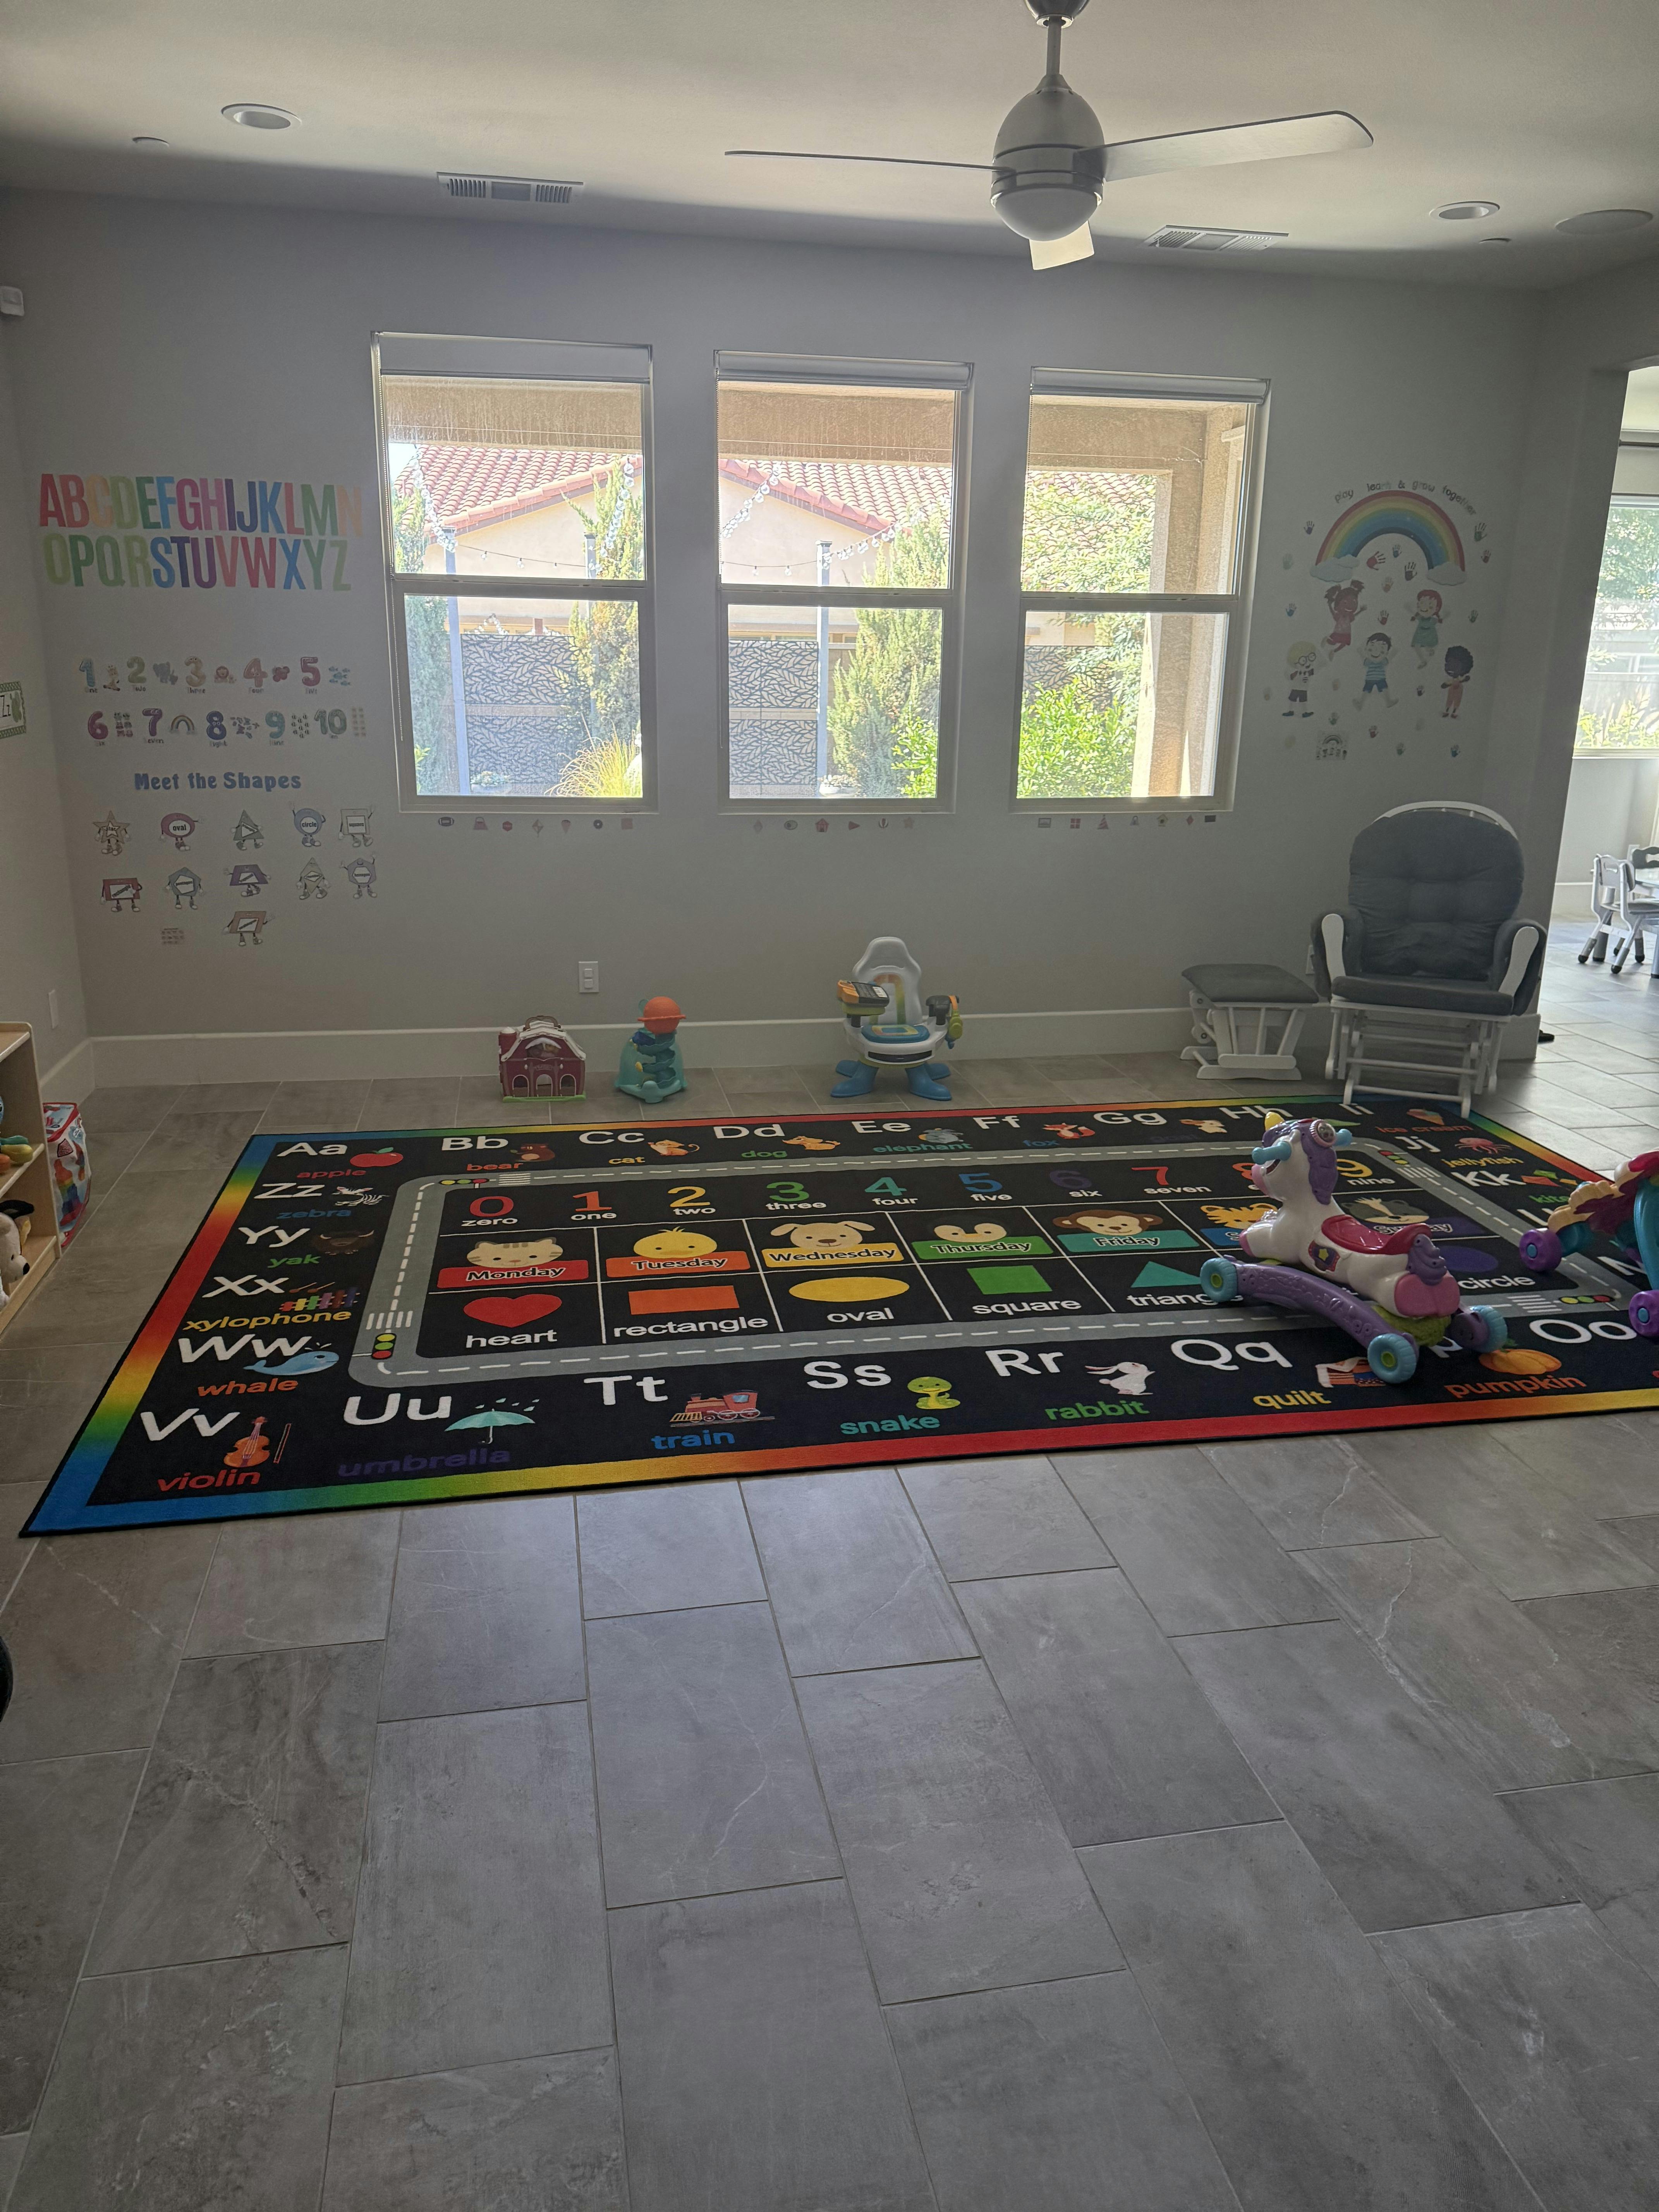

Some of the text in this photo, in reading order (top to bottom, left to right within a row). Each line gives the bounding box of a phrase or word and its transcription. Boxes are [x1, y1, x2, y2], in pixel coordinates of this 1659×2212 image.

[40, 474, 362, 537] ABCDEFGHIJKLMN
[1335, 489, 1353, 504] play
[1398, 480, 1405, 489] &
[1412, 481, 1436, 492] grow
[1443, 485, 1477, 515] together
[41, 534, 351, 591] OPQRSTUVWXYZ
[79, 659, 95, 687] 1
[127, 656, 147, 684] 2
[184, 656, 206, 687] 3
[243, 658, 268, 688] 4
[300, 657, 321, 687] 5
[88, 711, 108, 739] 6
[142, 708, 163, 737] 7
[206, 711, 227, 740] 8
[265, 710, 285, 739] 9
[314, 709, 347, 735] 10
[134, 772, 301, 792] Meet the Shapes
[1093, 1112, 1168, 1125] Gg
[1219, 1105, 1294, 1119] Hh
[713, 1124, 785, 1139] Dd
[852, 1121, 912, 1133] Ee
[972, 1116, 1020, 1129] Ff
[441, 1136, 509, 1151] Bb
[579, 1131, 645, 1144] Cc
[872, 1142, 974, 1152] elephant
[1022, 1139, 1061, 1147] fox
[1395, 1136, 1442, 1153] Jj
[277, 1142, 348, 1157] Aa
[741, 1150, 787, 1159] dog
[466, 1162, 523, 1171] bear
[1336, 1159, 1373, 1178] 9
[1441, 1156, 1524, 1168] jellyfish
[296, 1169, 367, 1179] apple
[959, 1173, 1003, 1193] 5
[1049, 1170, 1092, 1190] 6
[1131, 1166, 1169, 1186] 7
[1346, 1177, 1396, 1185] nine
[1450, 1170, 1527, 1187] Kk
[254, 1182, 325, 1199] Zz
[766, 1181, 810, 1202] 3
[864, 1177, 907, 1196] 4
[1069, 1189, 1103, 1198] six
[1144, 1185, 1212, 1195] seven
[573, 1191, 612, 1212] 1
[667, 1186, 711, 1207] 2
[872, 1197, 918, 1206] four
[276, 1209, 352, 1219] zebra
[673, 1207, 716, 1215] two
[766, 1202, 827, 1211] three
[461, 1218, 518, 1227] zero
[571, 1212, 617, 1221] one
[238, 1225, 311, 1248] Yy
[1373, 1225, 1453, 1234] Suay
[930, 1239, 1032, 1254] Thursday
[1093, 1235, 1160, 1247] Friday
[267, 1254, 322, 1268] yak
[631, 1257, 728, 1271] Tuesday
[769, 1247, 895, 1262] Wednesday
[466, 1267, 566, 1281] Monday
[1458, 1275, 1536, 1290] circle
[202, 1274, 290, 1298] Xx
[974, 1299, 1082, 1316] square
[1127, 1294, 1244, 1305] triang
[182, 1310, 352, 1332] xylophone
[827, 1307, 895, 1323] oval
[613, 1317, 769, 1338] rectangle
[1529, 1319, 1638, 1344] Oo
[178, 1333, 313, 1363] Ww
[465, 1329, 558, 1348] heart
[985, 1348, 1064, 1377] Rr
[1171, 1339, 1293, 1371] Qq
[804, 1360, 892, 1389] Ss
[198, 1378, 299, 1397] whale
[584, 1375, 668, 1405] Tt
[1444, 1375, 1587, 1399] pumpkin
[343, 1393, 452, 1425] Uu
[1253, 1390, 1332, 1410] quilt
[1044, 1400, 1151, 1420] rabbit
[140, 1408, 240, 1441] Vv
[840, 1414, 941, 1435] snake
[651, 1429, 735, 1450] train
[338, 1447, 512, 1477] umbrella
[156, 1468, 261, 1492] violin
